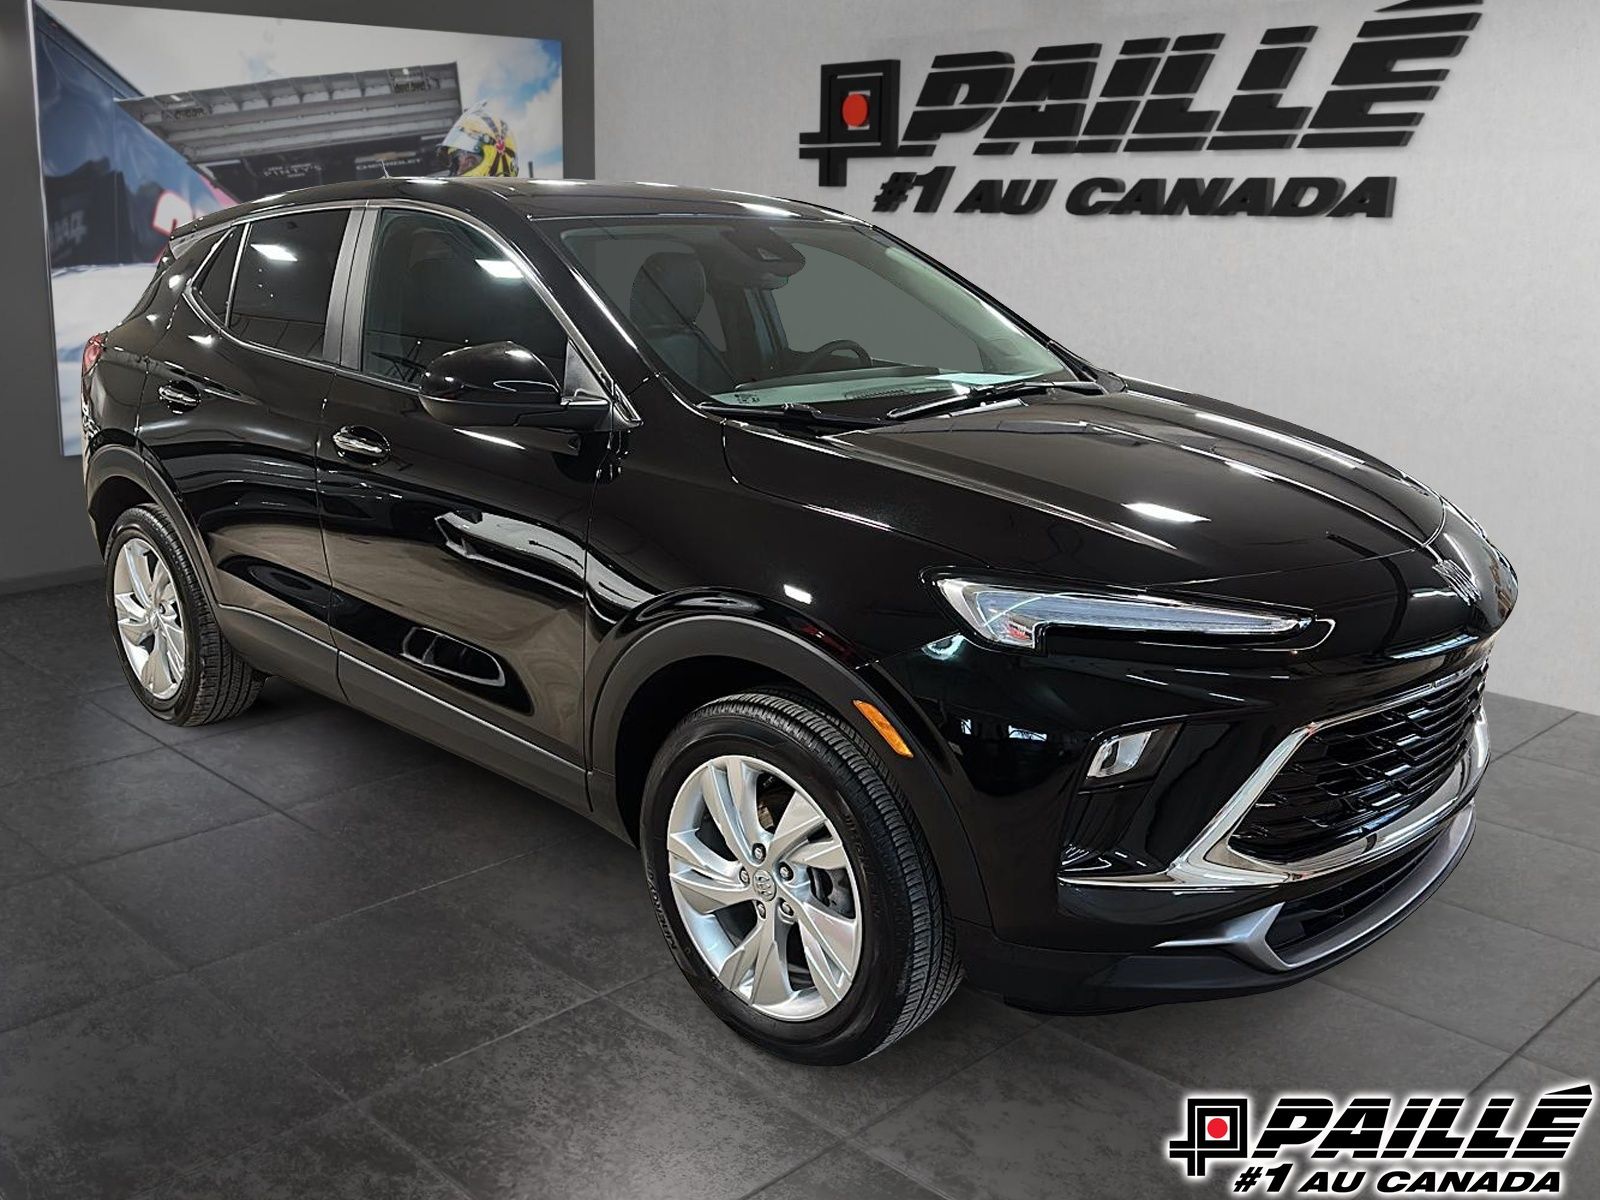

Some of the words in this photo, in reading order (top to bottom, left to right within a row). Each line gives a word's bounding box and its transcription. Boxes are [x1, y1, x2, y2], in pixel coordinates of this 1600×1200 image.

[899, 0, 1484, 155] PAILLÉ
[872, 165, 956, 214] #1
[954, 178, 1058, 216] AU
[1065, 176, 1397, 218] CANADA
